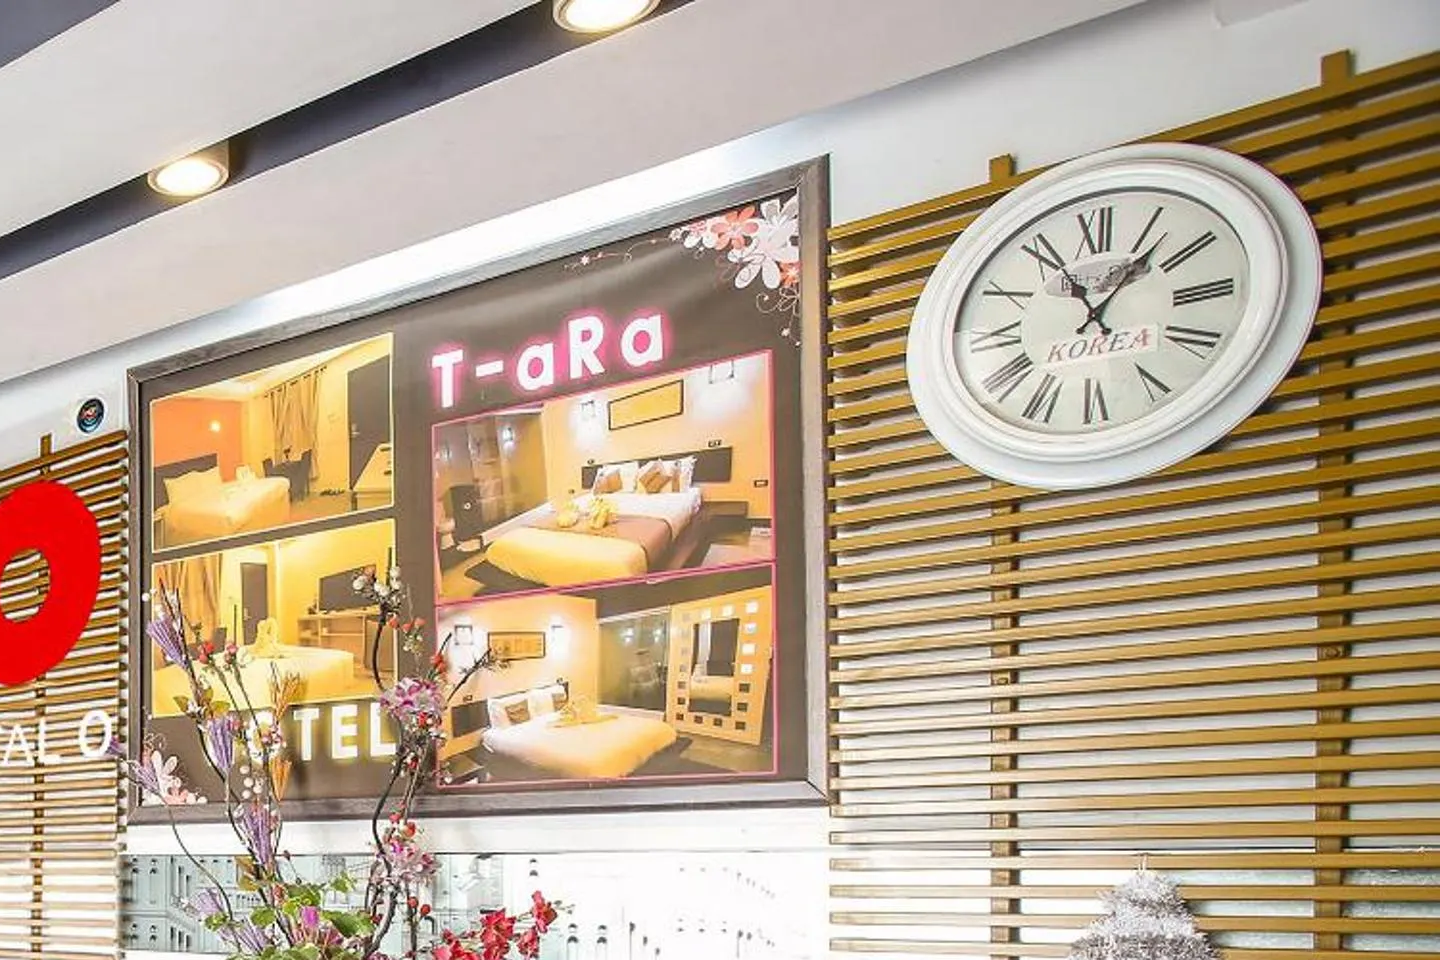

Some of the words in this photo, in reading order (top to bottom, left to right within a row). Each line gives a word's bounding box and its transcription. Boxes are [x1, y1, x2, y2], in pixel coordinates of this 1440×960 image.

[1075, 206, 1112, 261] XII
[431, 314, 664, 409] T-aRa
[1046, 327, 1150, 362] KOREA
[68, 709, 112, 758] O
